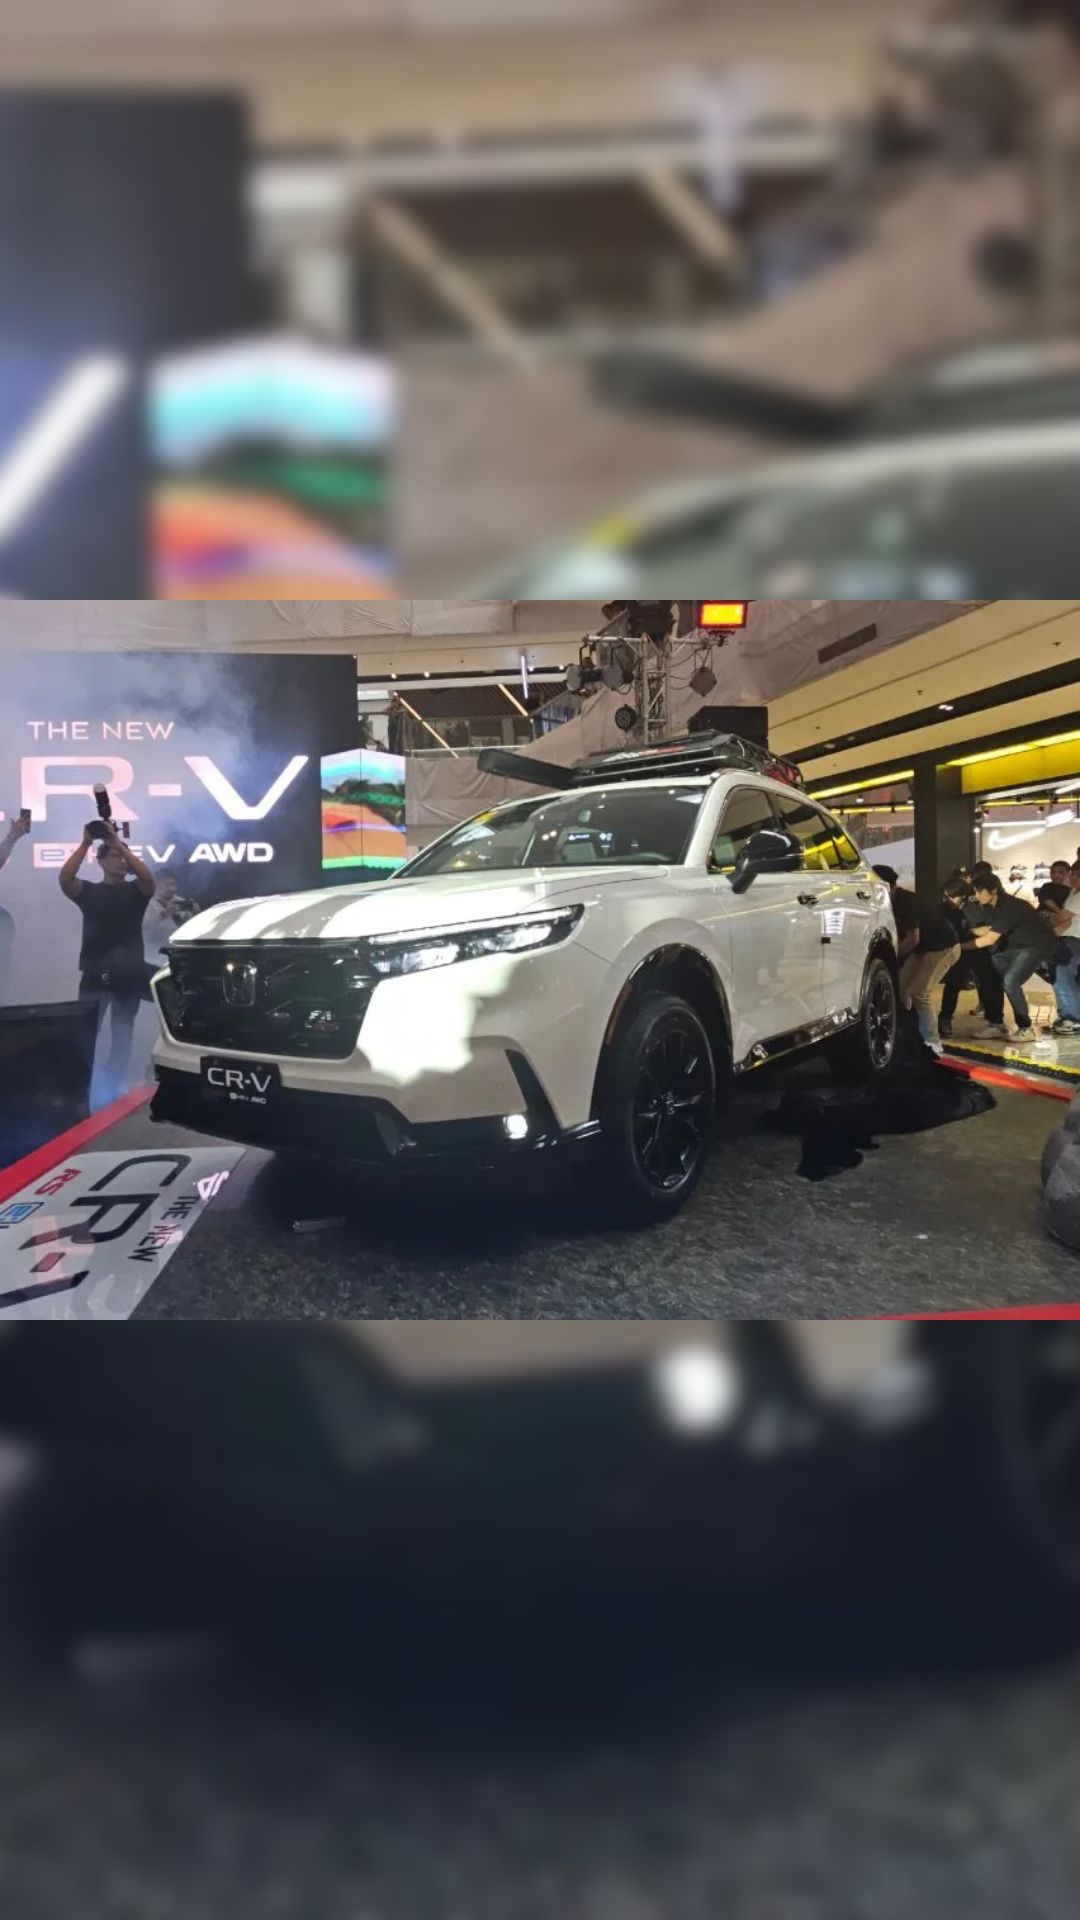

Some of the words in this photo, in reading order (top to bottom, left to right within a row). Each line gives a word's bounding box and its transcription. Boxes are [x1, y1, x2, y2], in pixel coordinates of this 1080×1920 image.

[27, 721, 89, 740] THE
[103, 721, 174, 740] NEW
[0, 755, 309, 822] R-V
[189, 842, 274, 864] AWD
[207, 1067, 272, 1092] CR-V
[34, 1168, 82, 1196] RS
[127, 1224, 181, 1262] NEW
